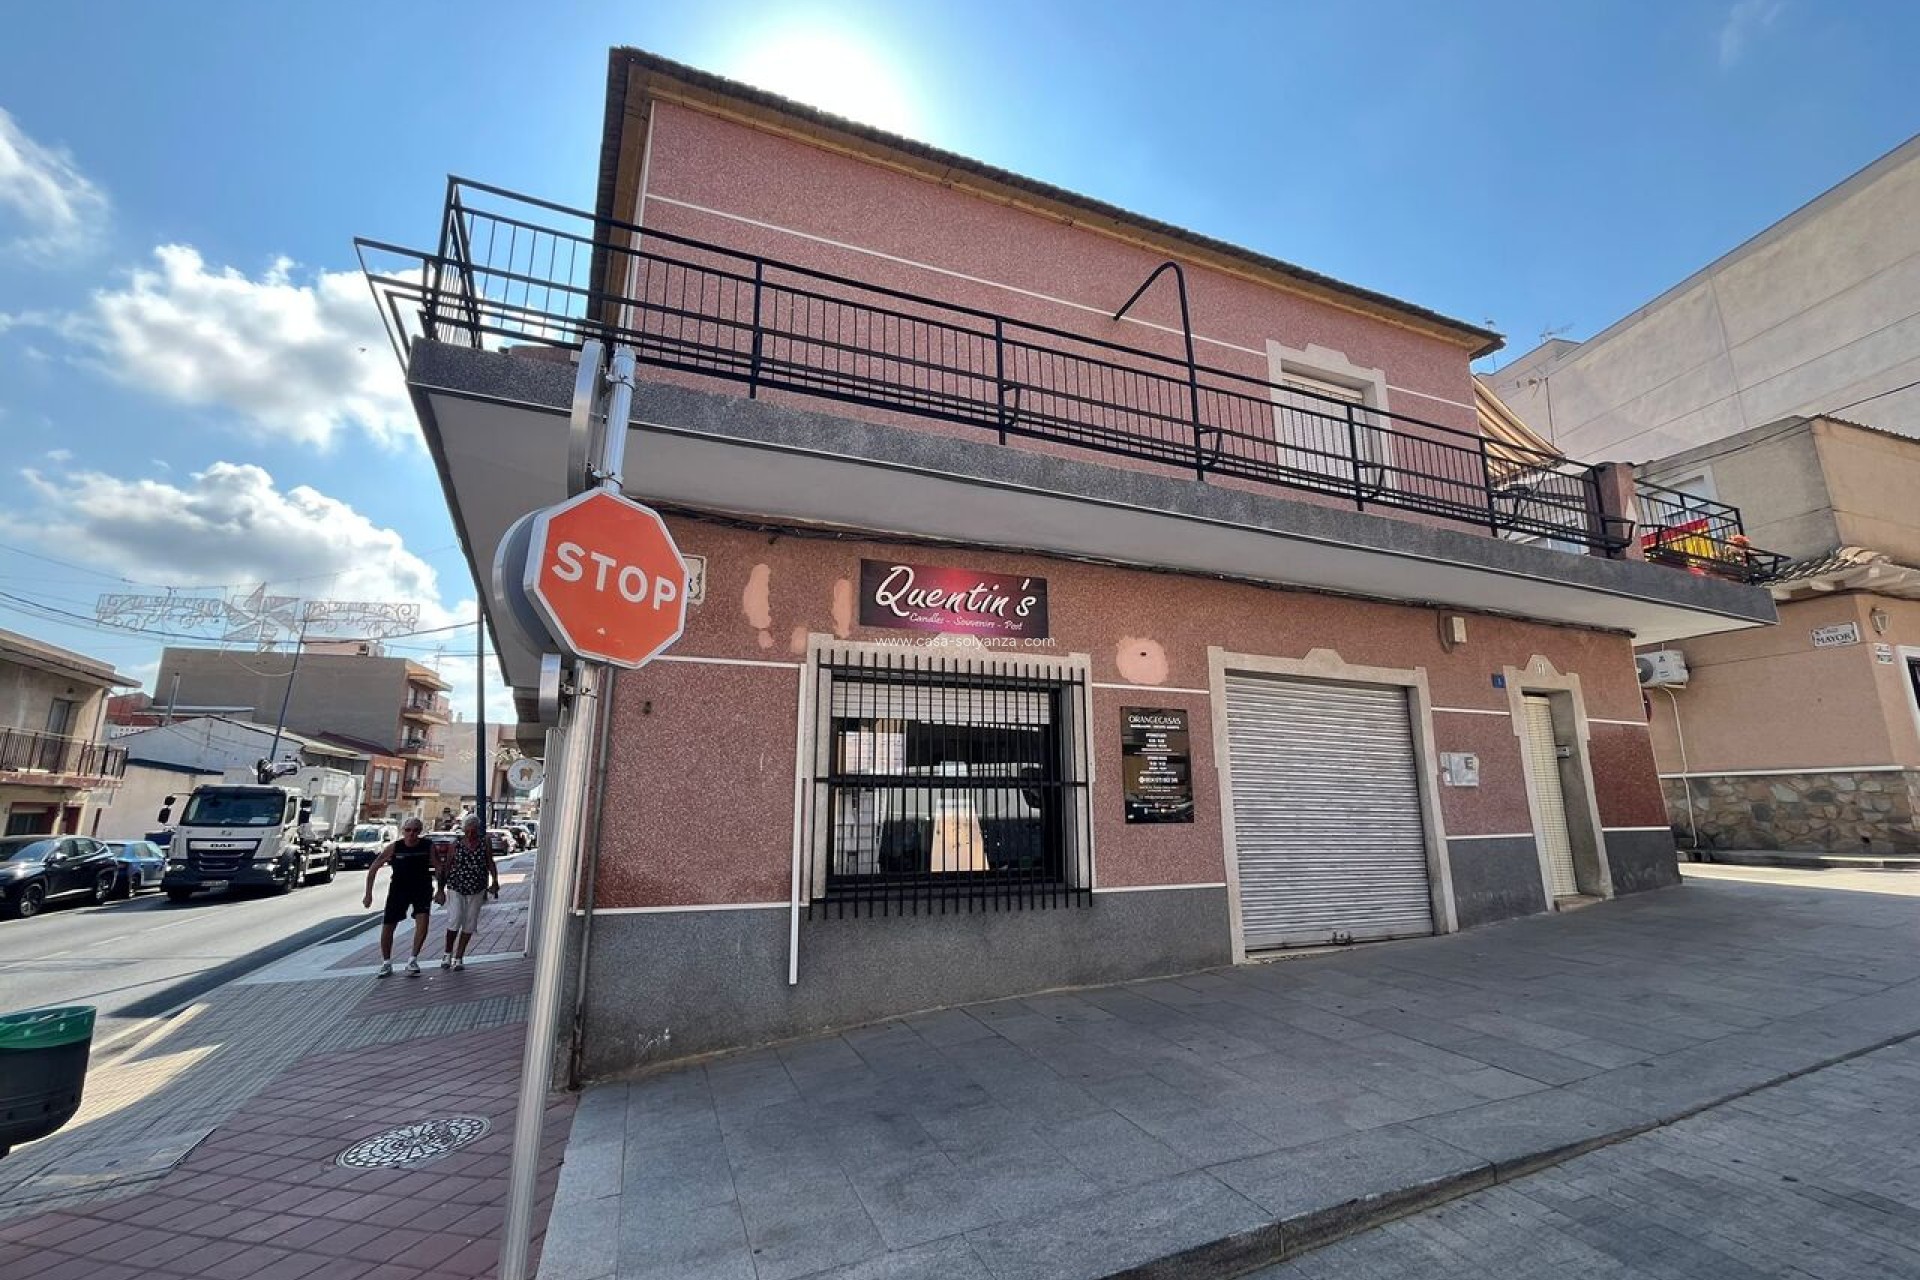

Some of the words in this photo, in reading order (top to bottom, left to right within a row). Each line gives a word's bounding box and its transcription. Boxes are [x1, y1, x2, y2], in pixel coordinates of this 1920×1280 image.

[551, 541, 676, 610] STOP
[875, 565, 1037, 617] Quentin's
[1816, 633, 1852, 643] MAYOR
